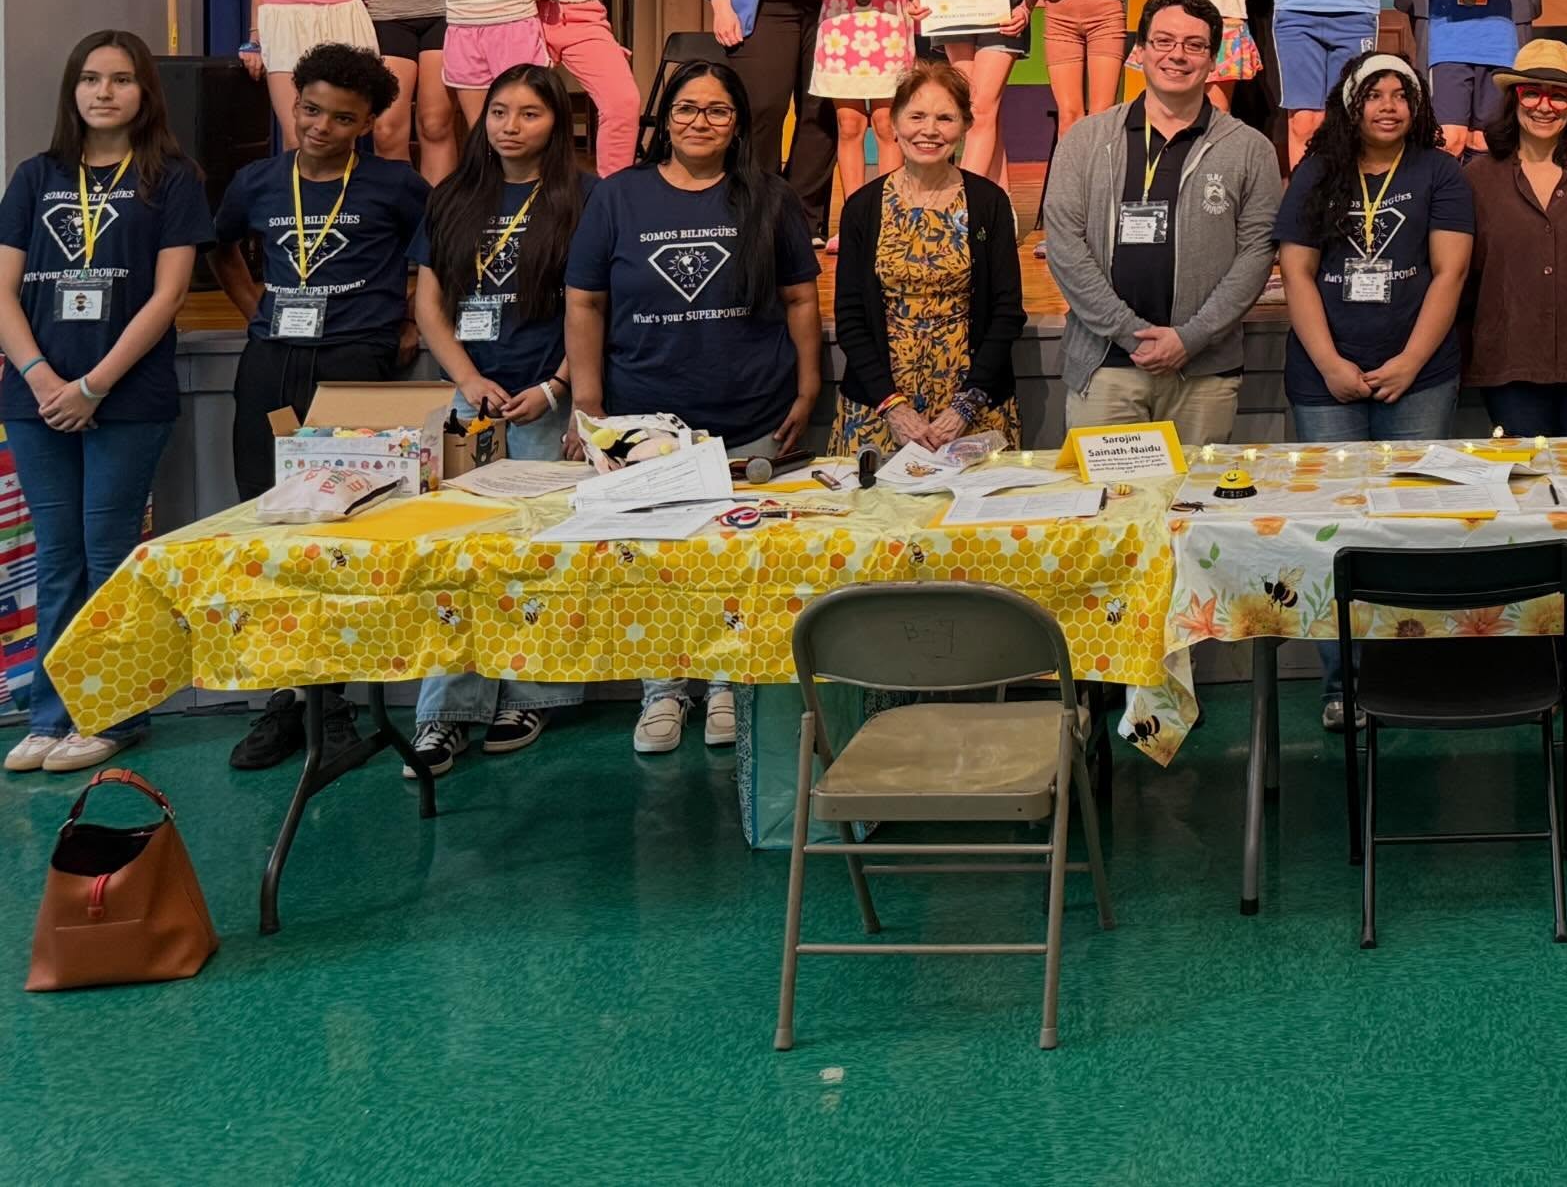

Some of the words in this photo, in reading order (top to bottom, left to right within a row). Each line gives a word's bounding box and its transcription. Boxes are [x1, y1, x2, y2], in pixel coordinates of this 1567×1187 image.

[43, 191, 79, 202] SOMOS
[268, 217, 299, 227] SOMO
[640, 230, 678, 242] SOMOS
[680, 225, 738, 239] BILINGÜES
[633, 313, 660, 324] What's
[662, 313, 684, 324] your
[1102, 433, 1141, 445] Sarojini
[1088, 445, 1161, 457] Sainath-Naidu
